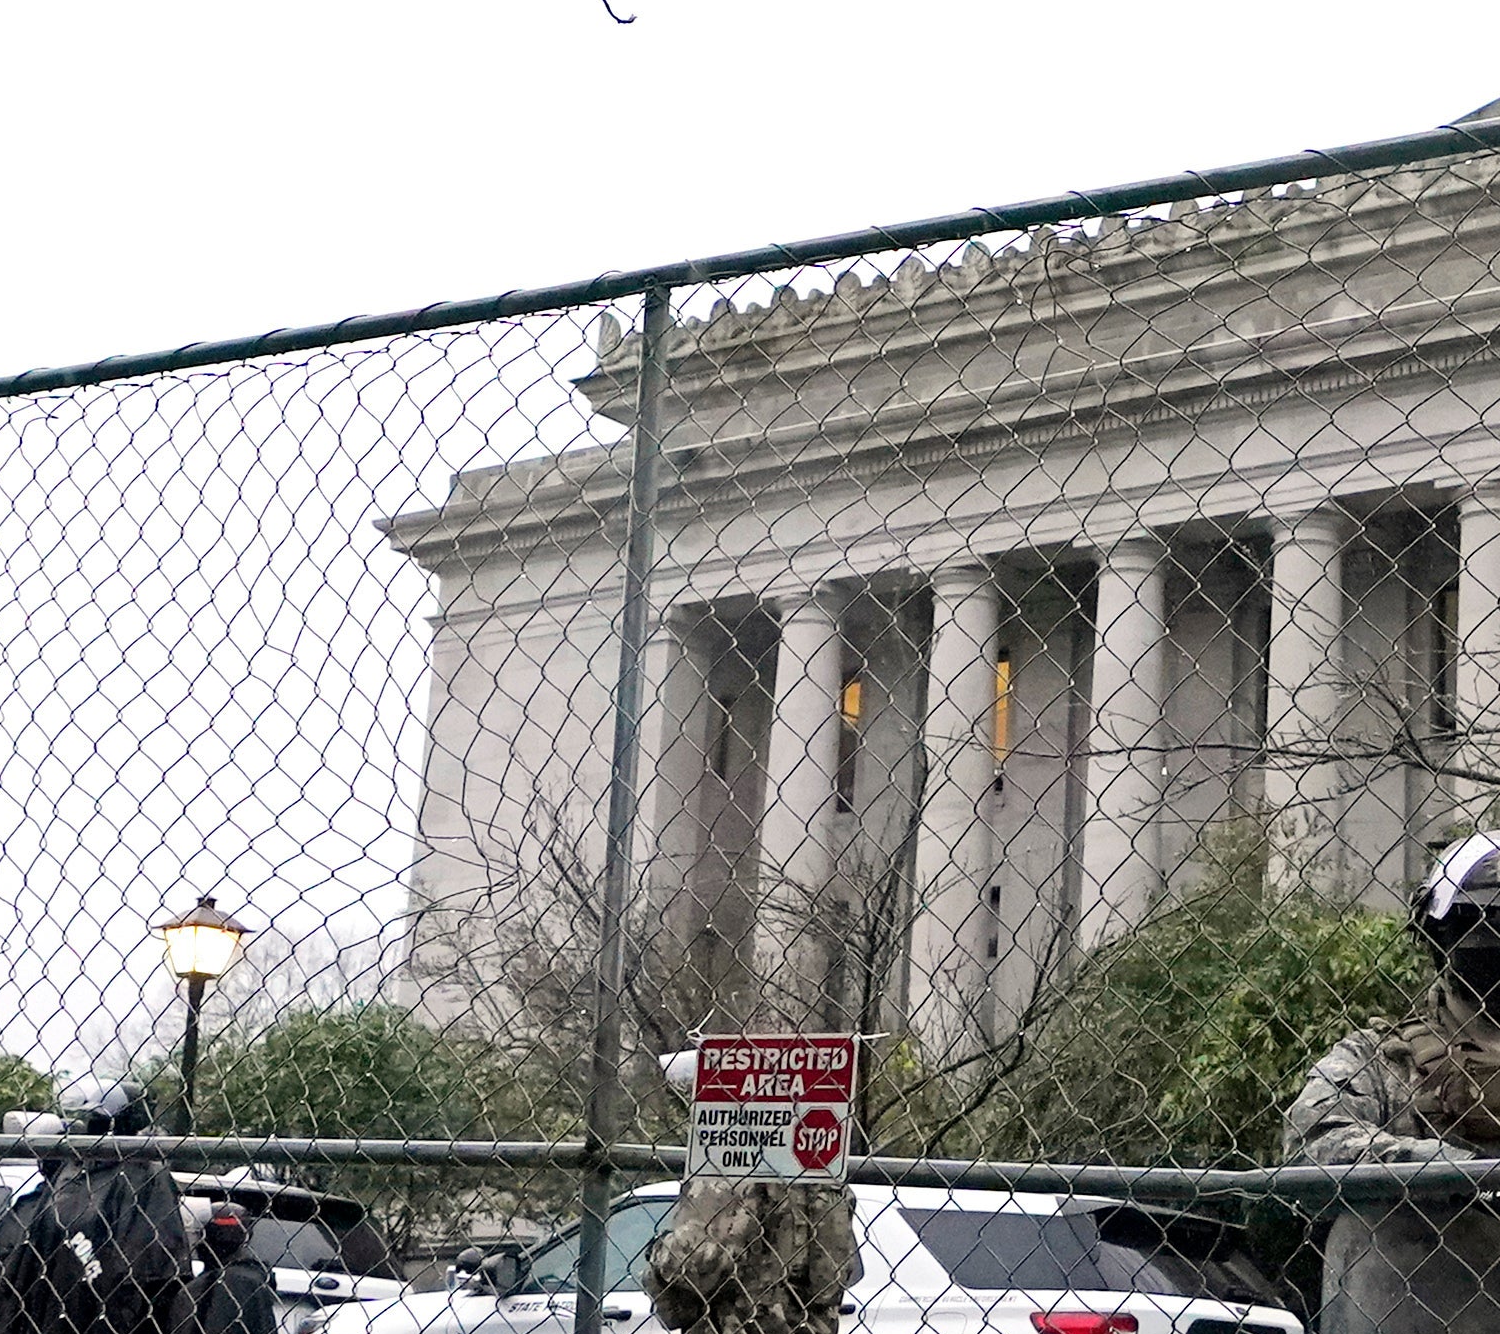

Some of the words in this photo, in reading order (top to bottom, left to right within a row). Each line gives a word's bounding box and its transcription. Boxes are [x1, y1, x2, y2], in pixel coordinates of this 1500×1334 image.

[703, 1047, 849, 1071] RESTRICTED
[740, 1074, 805, 1096] AREA
[697, 1109, 792, 1126] AUTHORIZED
[699, 1130, 787, 1147] PERSONNEL
[797, 1127, 839, 1152] STOP
[722, 1151, 760, 1167] ONLY
